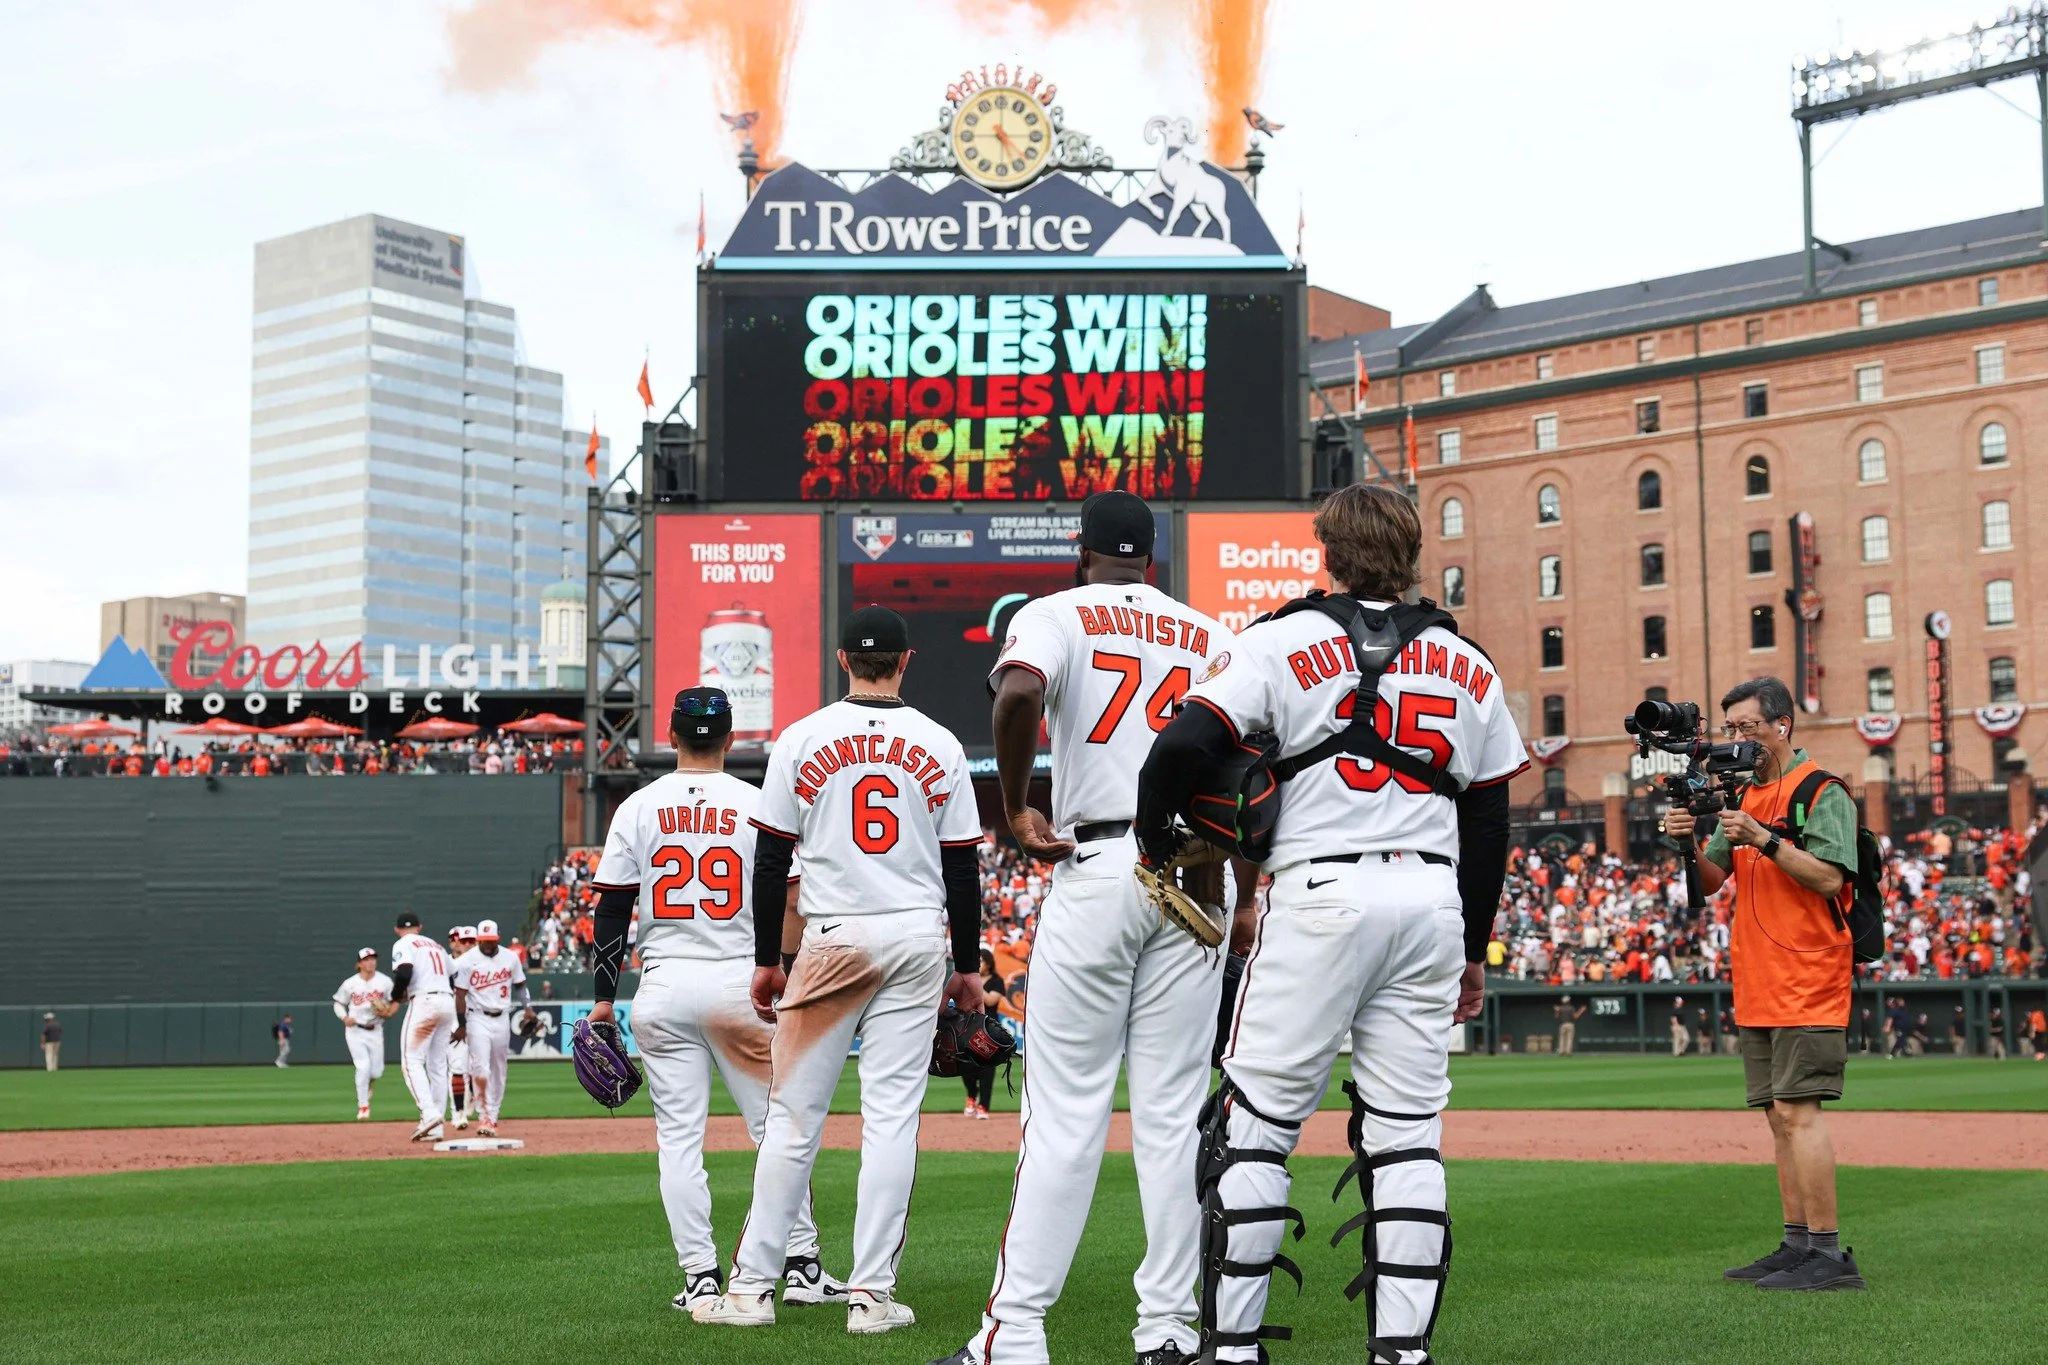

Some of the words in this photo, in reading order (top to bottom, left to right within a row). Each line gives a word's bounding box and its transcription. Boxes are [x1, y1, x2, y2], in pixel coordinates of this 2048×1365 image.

[962, 201, 1092, 251] Price
[806, 295, 1057, 336] ORIOLES
[1066, 295, 1208, 330] WIN!
[804, 332, 1056, 380] ORIOLES
[1062, 326, 1206, 373] WIN!
[803, 373, 1054, 420] ORIOLES
[1061, 371, 1205, 416] WIN!
[988, 528, 1013, 540] LIVE
[1014, 528, 1048, 540] AUDIO
[990, 517, 1036, 528] STREAM
[1037, 517, 1060, 528] MLB
[690, 543, 730, 562] THIS
[733, 543, 786, 562] BUD'S
[702, 564, 736, 583] FOR
[738, 564, 774, 583] YOU
[1219, 540, 1320, 574] Boring
[1226, 579, 1315, 600] never
[169, 619, 370, 690] Coors
[382, 642, 567, 688] LIGHT
[1076, 606, 1209, 658] BAUTISTA
[1287, 635, 1493, 704] RUTHMAN
[165, 692, 302, 715] ROOF
[350, 690, 481, 714] DECK
[1085, 650, 1191, 744] 74
[1335, 688, 1457, 794] 35
[794, 735, 950, 814] MOUNTCASTLE
[657, 800, 738, 836] URÍAS
[852, 775, 899, 854] 6
[651, 845, 743, 921] 29
[501, 985, 509, 998] 3
